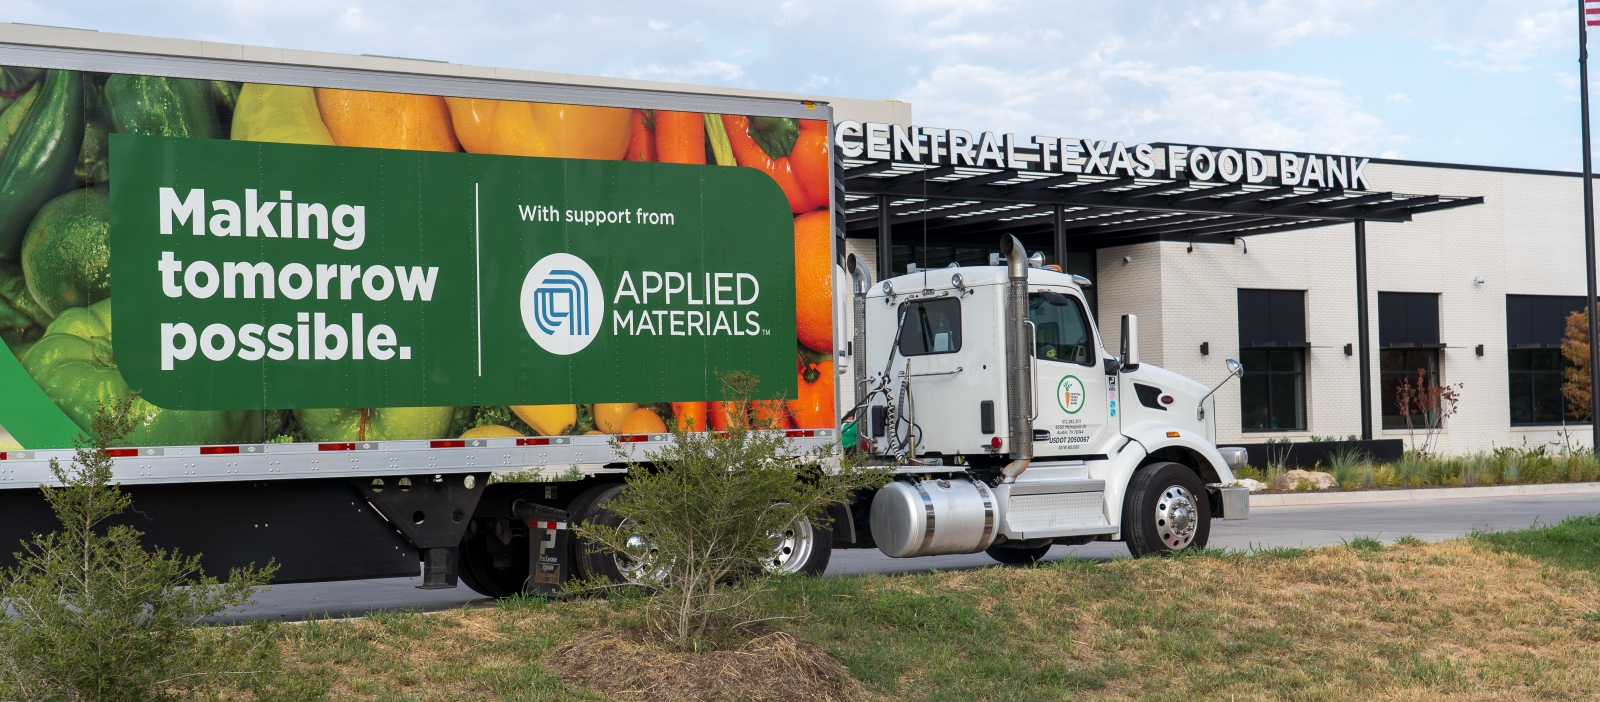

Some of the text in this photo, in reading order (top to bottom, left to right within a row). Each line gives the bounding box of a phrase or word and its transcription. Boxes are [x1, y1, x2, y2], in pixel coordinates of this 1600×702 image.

[835, 119, 1371, 191] CENTRAL TEXAS FOOD BANK
[159, 187, 366, 250] Making
[518, 204, 675, 226] With support from
[158, 251, 439, 301] tomorrow
[613, 270, 760, 306] APPLIED
[160, 312, 412, 371] possible.
[613, 310, 761, 336] MATERIALS
